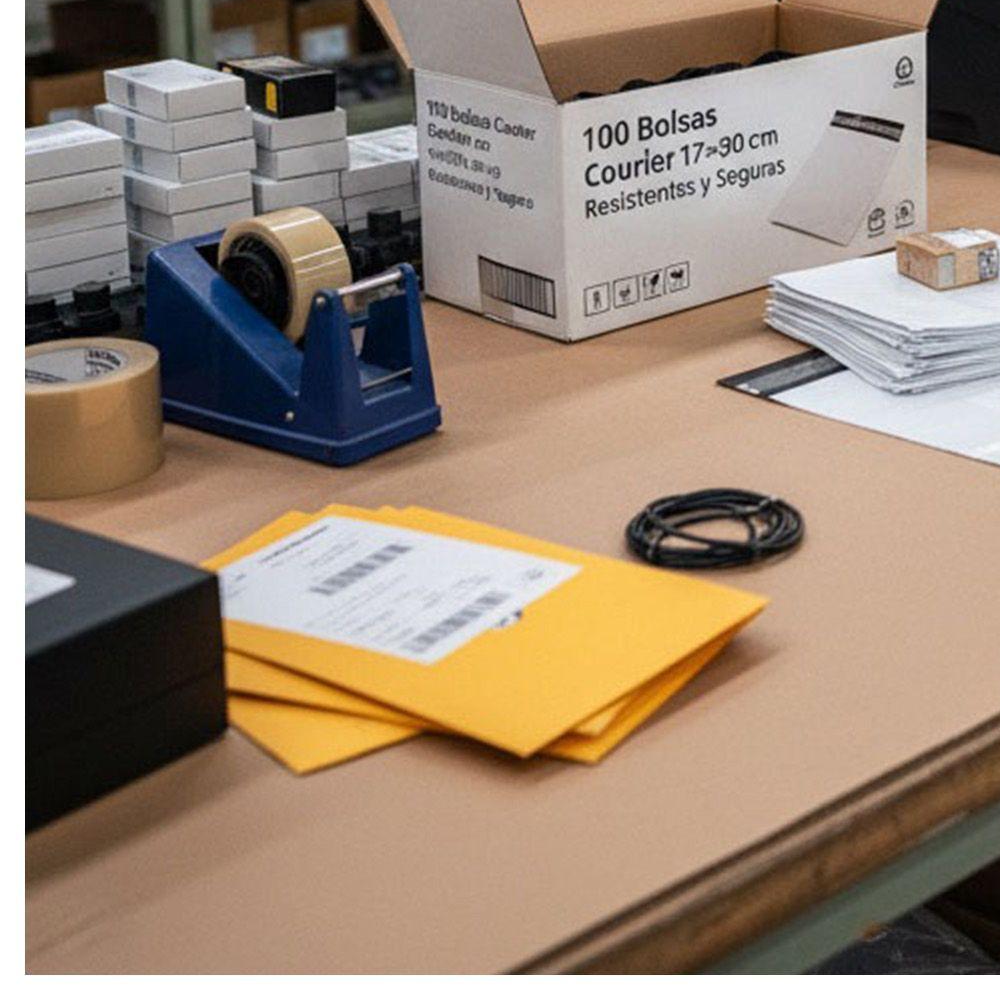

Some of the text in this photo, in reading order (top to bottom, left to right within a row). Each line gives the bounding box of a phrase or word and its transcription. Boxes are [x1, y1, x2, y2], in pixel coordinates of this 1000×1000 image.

[583, 108, 718, 152] 100 Bolsas
[584, 148, 676, 188] Courier
[748, 129, 779, 150] cm
[700, 176, 711, 198] y
[716, 159, 786, 188] Seguras
